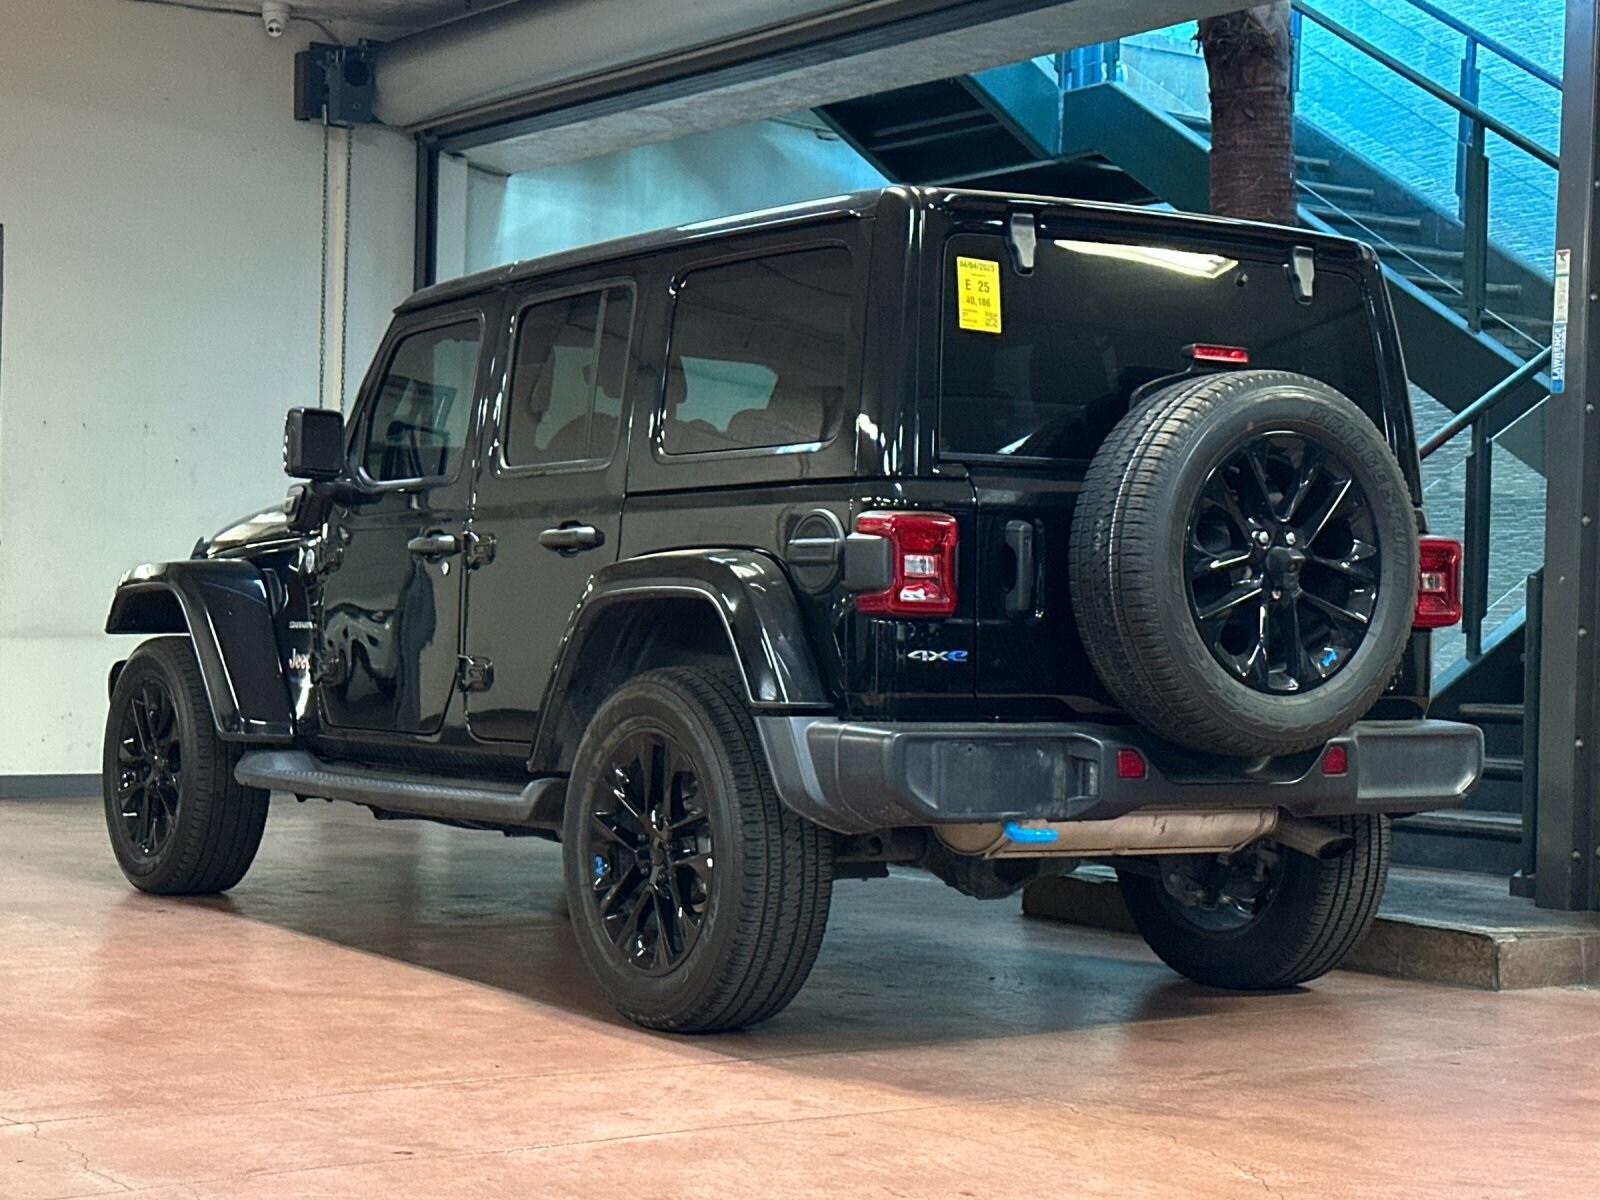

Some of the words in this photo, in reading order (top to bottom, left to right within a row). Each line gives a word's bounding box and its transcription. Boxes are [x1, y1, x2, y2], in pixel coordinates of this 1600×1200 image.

[965, 279, 972, 291] E
[977, 281, 990, 293] 25
[1552, 327, 1562, 380] LAWRENCE
